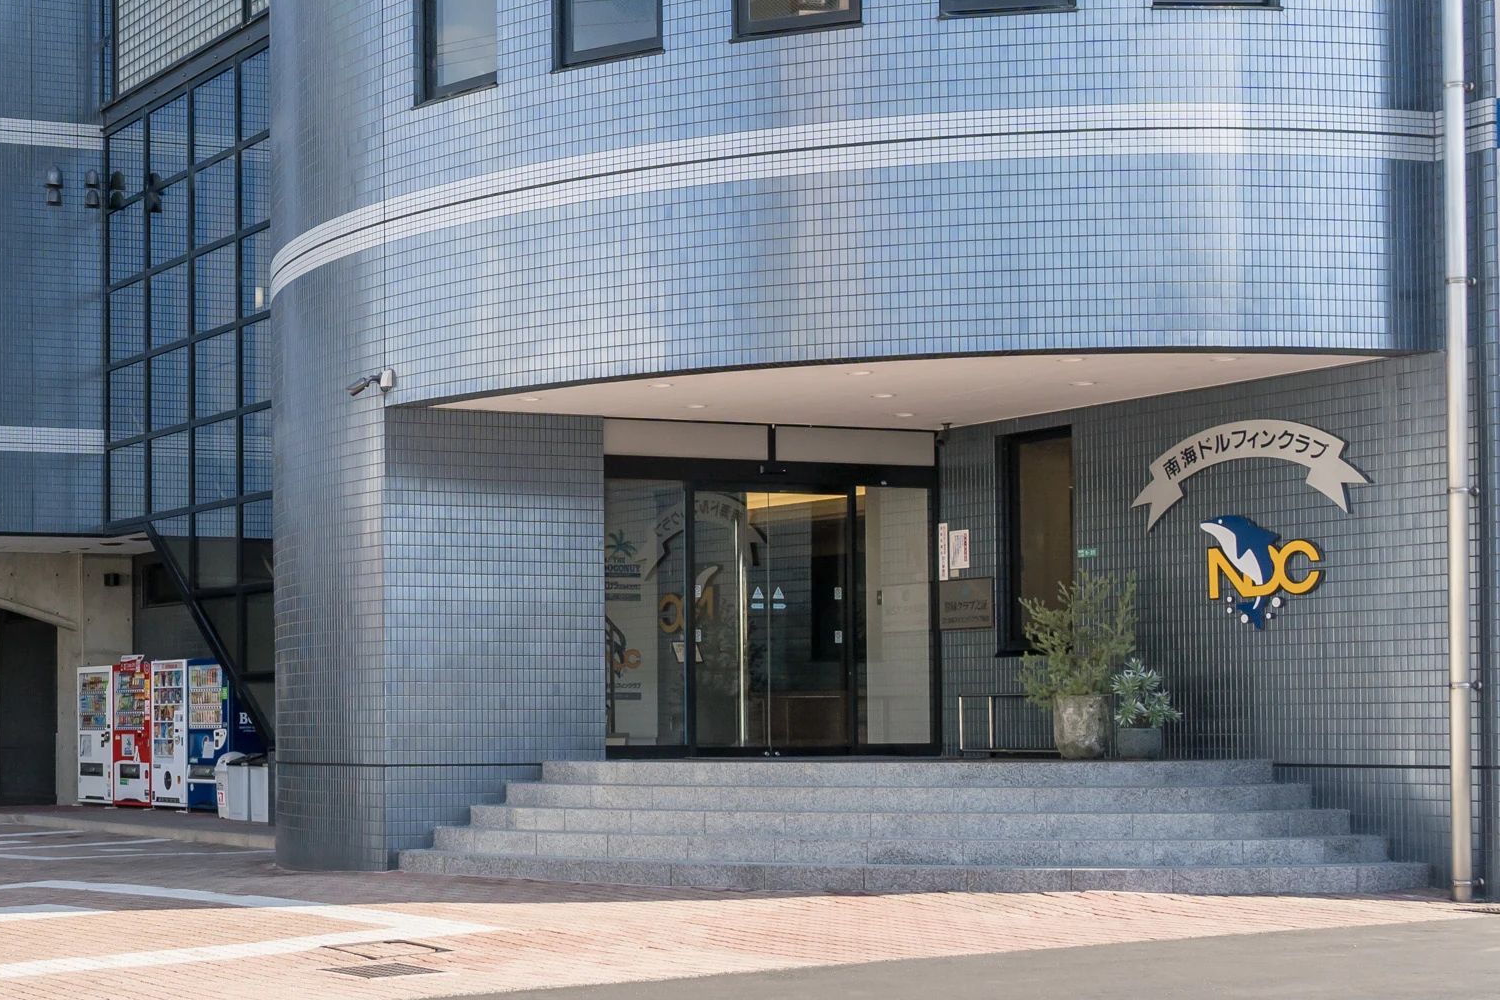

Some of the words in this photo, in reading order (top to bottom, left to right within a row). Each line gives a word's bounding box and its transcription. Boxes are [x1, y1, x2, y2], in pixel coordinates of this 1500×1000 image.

[1162, 429, 1330, 481] 南海ドルフィンクラブ
